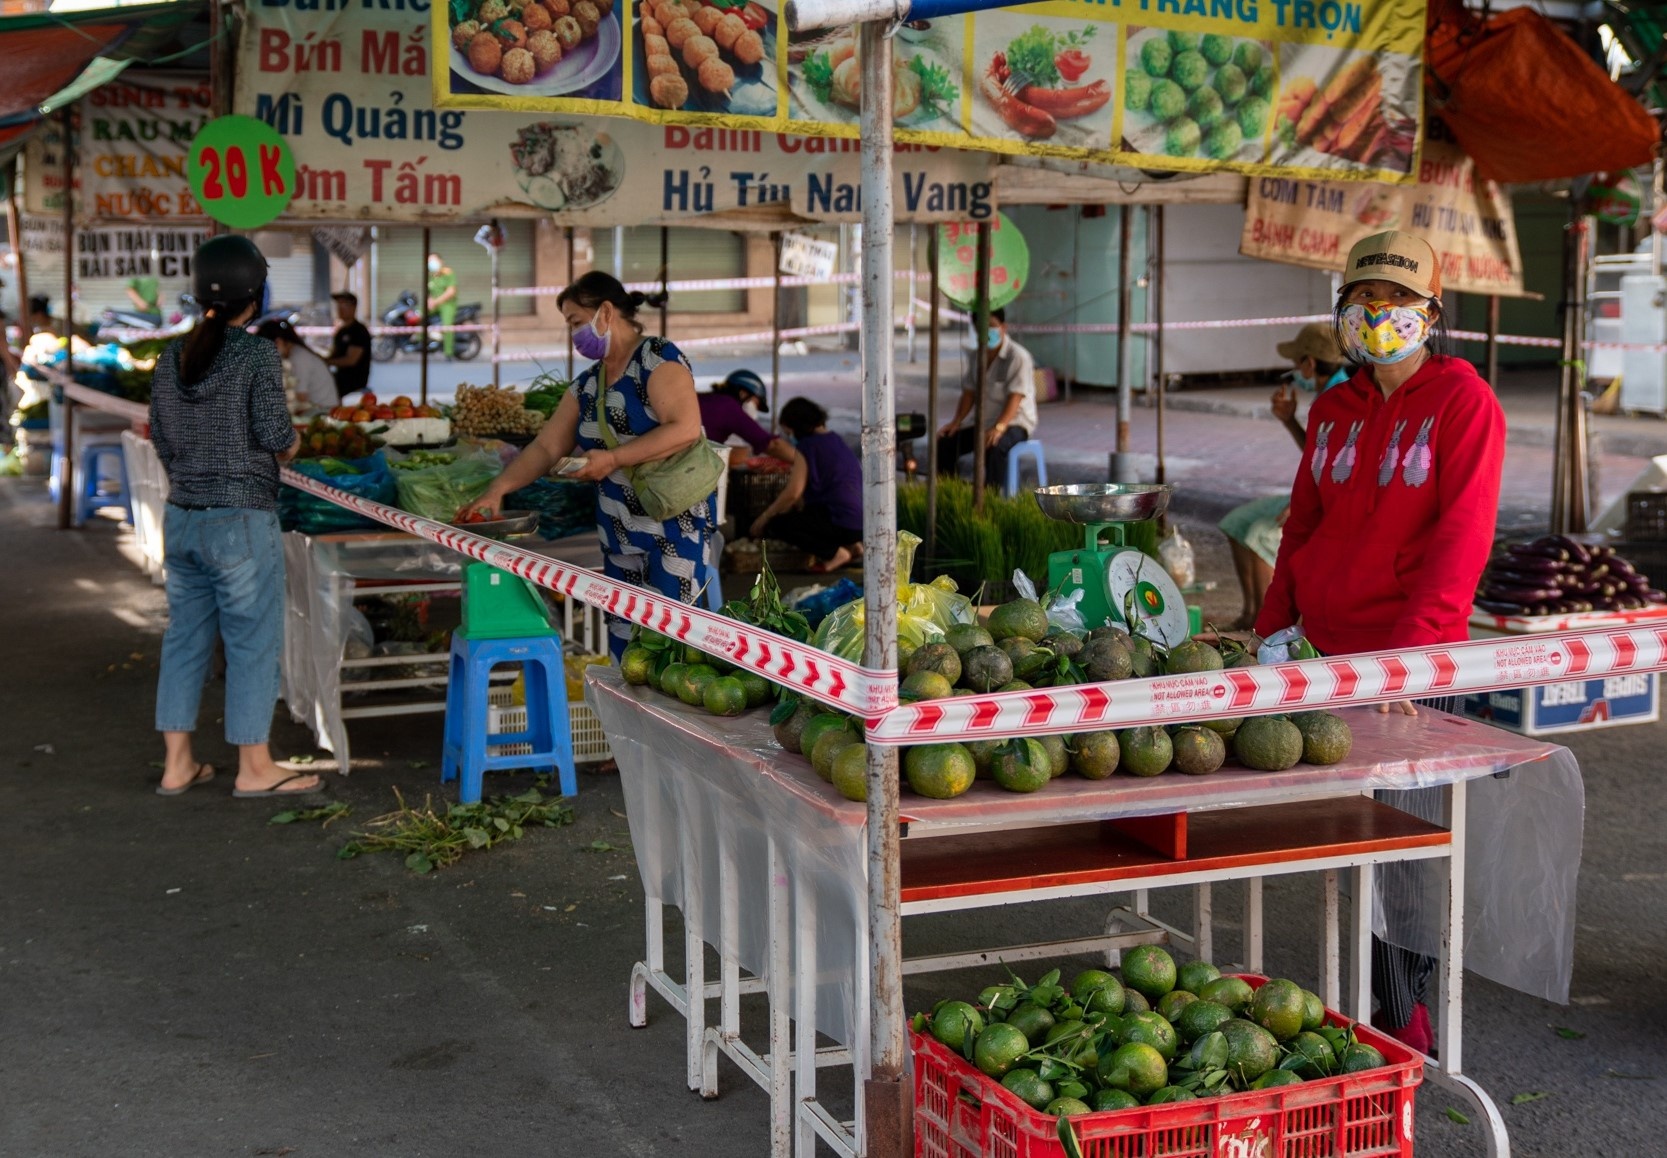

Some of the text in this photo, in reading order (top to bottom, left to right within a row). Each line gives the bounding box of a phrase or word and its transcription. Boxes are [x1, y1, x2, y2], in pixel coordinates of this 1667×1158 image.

[92, 117, 160, 141] RAU
[322, 91, 466, 150] Quảng
[200, 144, 285, 200] 20 K
[363, 155, 462, 205] Tấm
[663, 166, 714, 212] Hủ
[807, 173, 861, 213] Na
[903, 172, 993, 219] Vang
[1496, 655, 1547, 667] NOT ALLOWED AREA
[1153, 688, 1209, 701] NOT ALLOWED AREA
